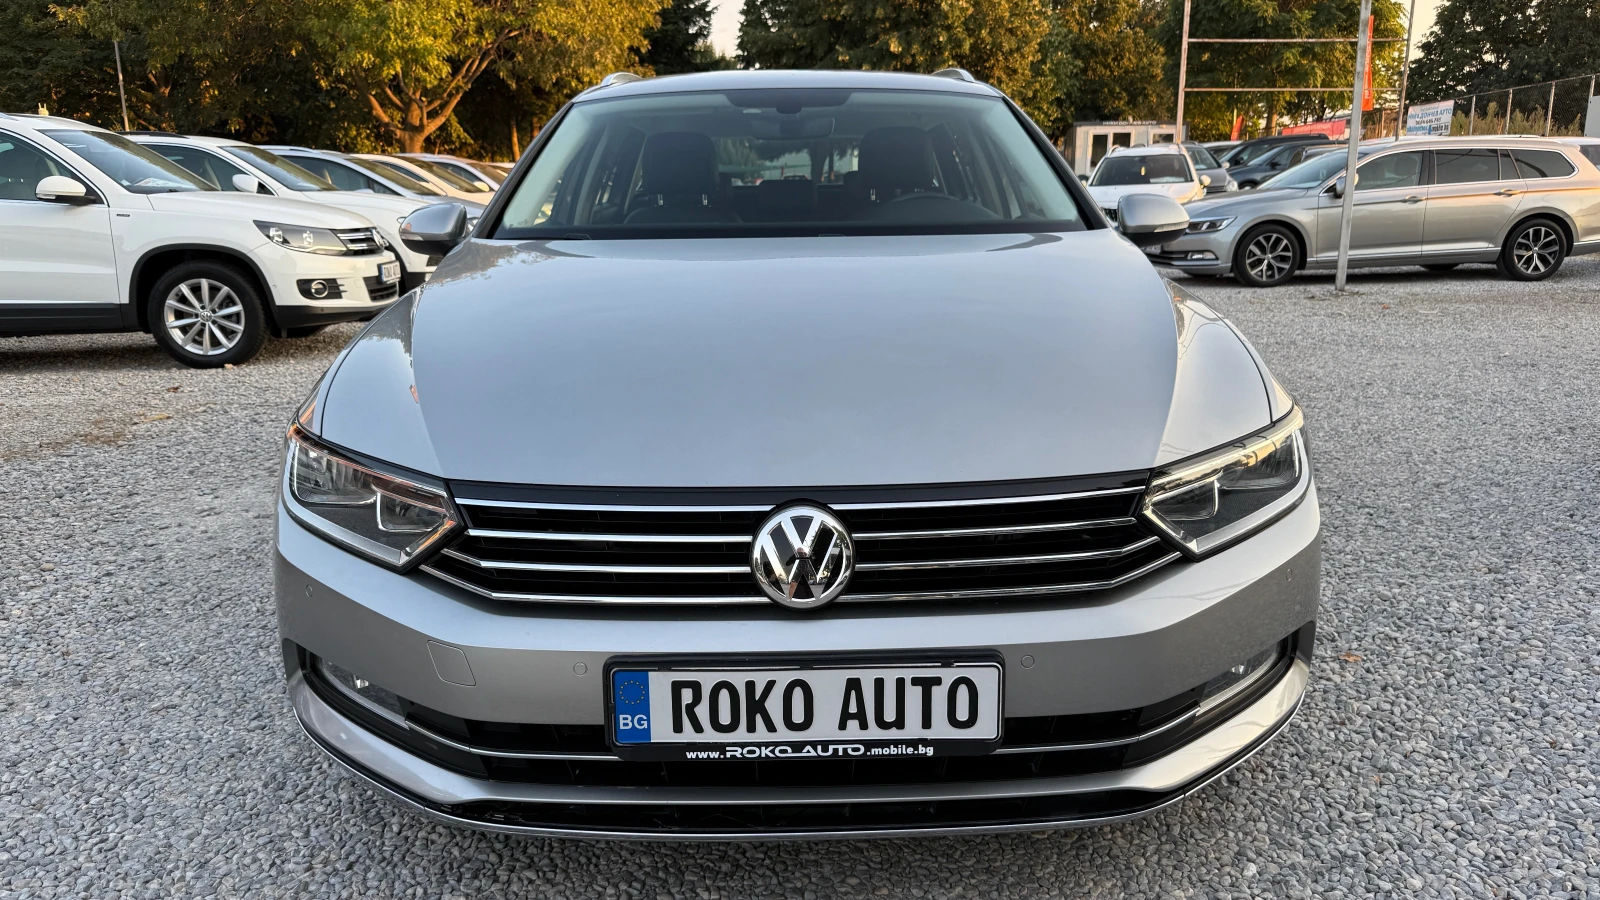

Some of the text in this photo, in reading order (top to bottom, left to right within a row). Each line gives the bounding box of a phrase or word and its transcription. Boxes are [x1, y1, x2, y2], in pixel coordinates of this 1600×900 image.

[619, 714, 648, 730] BG
[671, 675, 979, 734] ROKO AUTO
